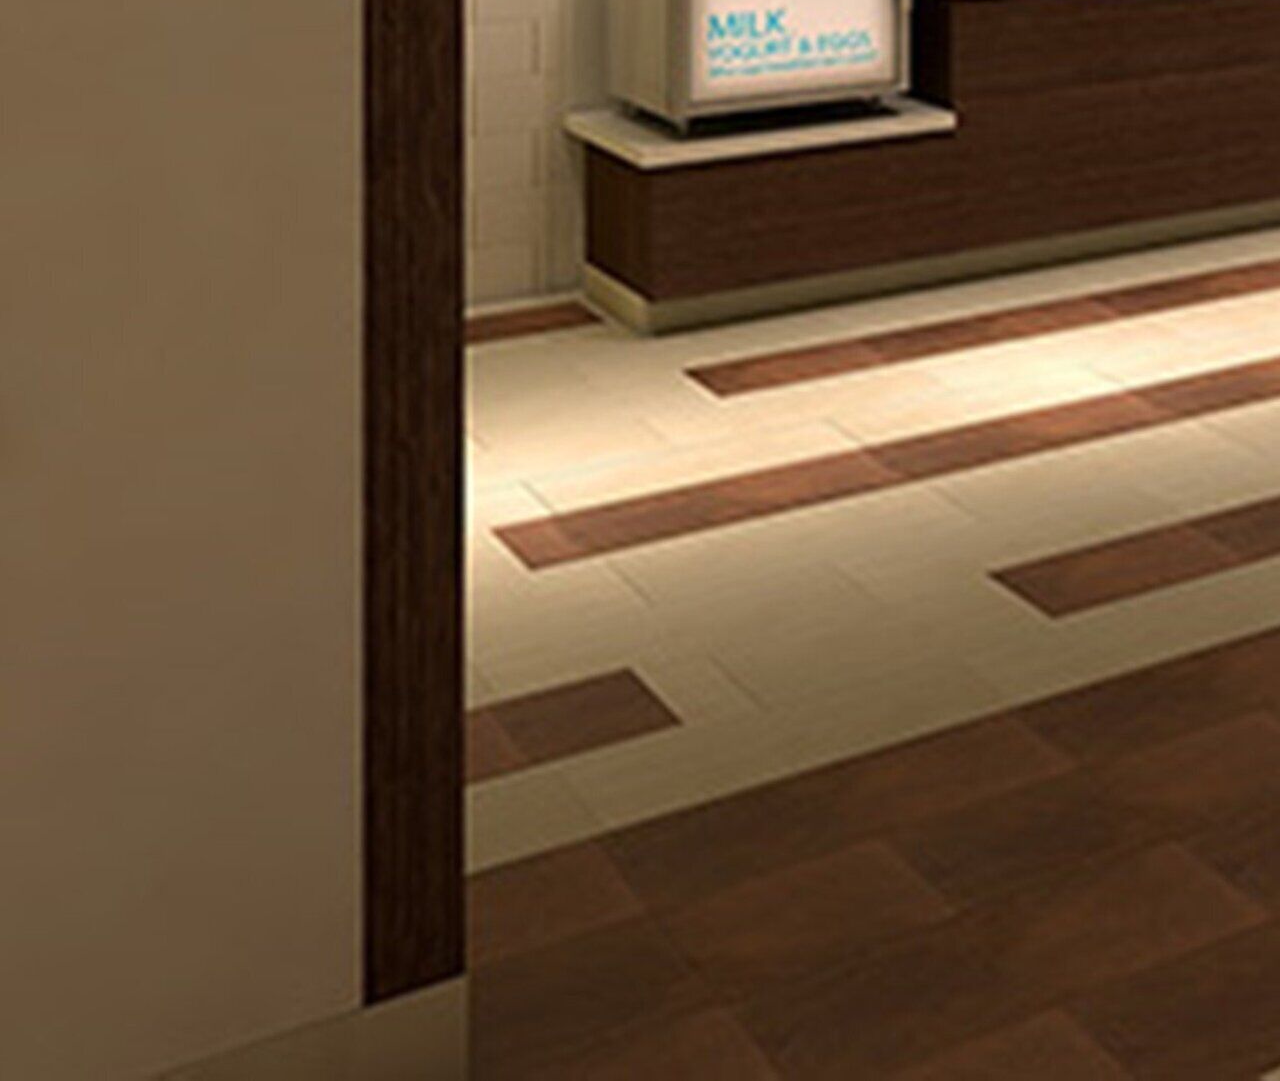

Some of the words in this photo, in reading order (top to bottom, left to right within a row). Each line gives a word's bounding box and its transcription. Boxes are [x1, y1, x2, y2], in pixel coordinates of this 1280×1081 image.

[707, 8, 786, 40] MILK
[708, 35, 792, 61] YOGURT
[798, 37, 812, 53] &
